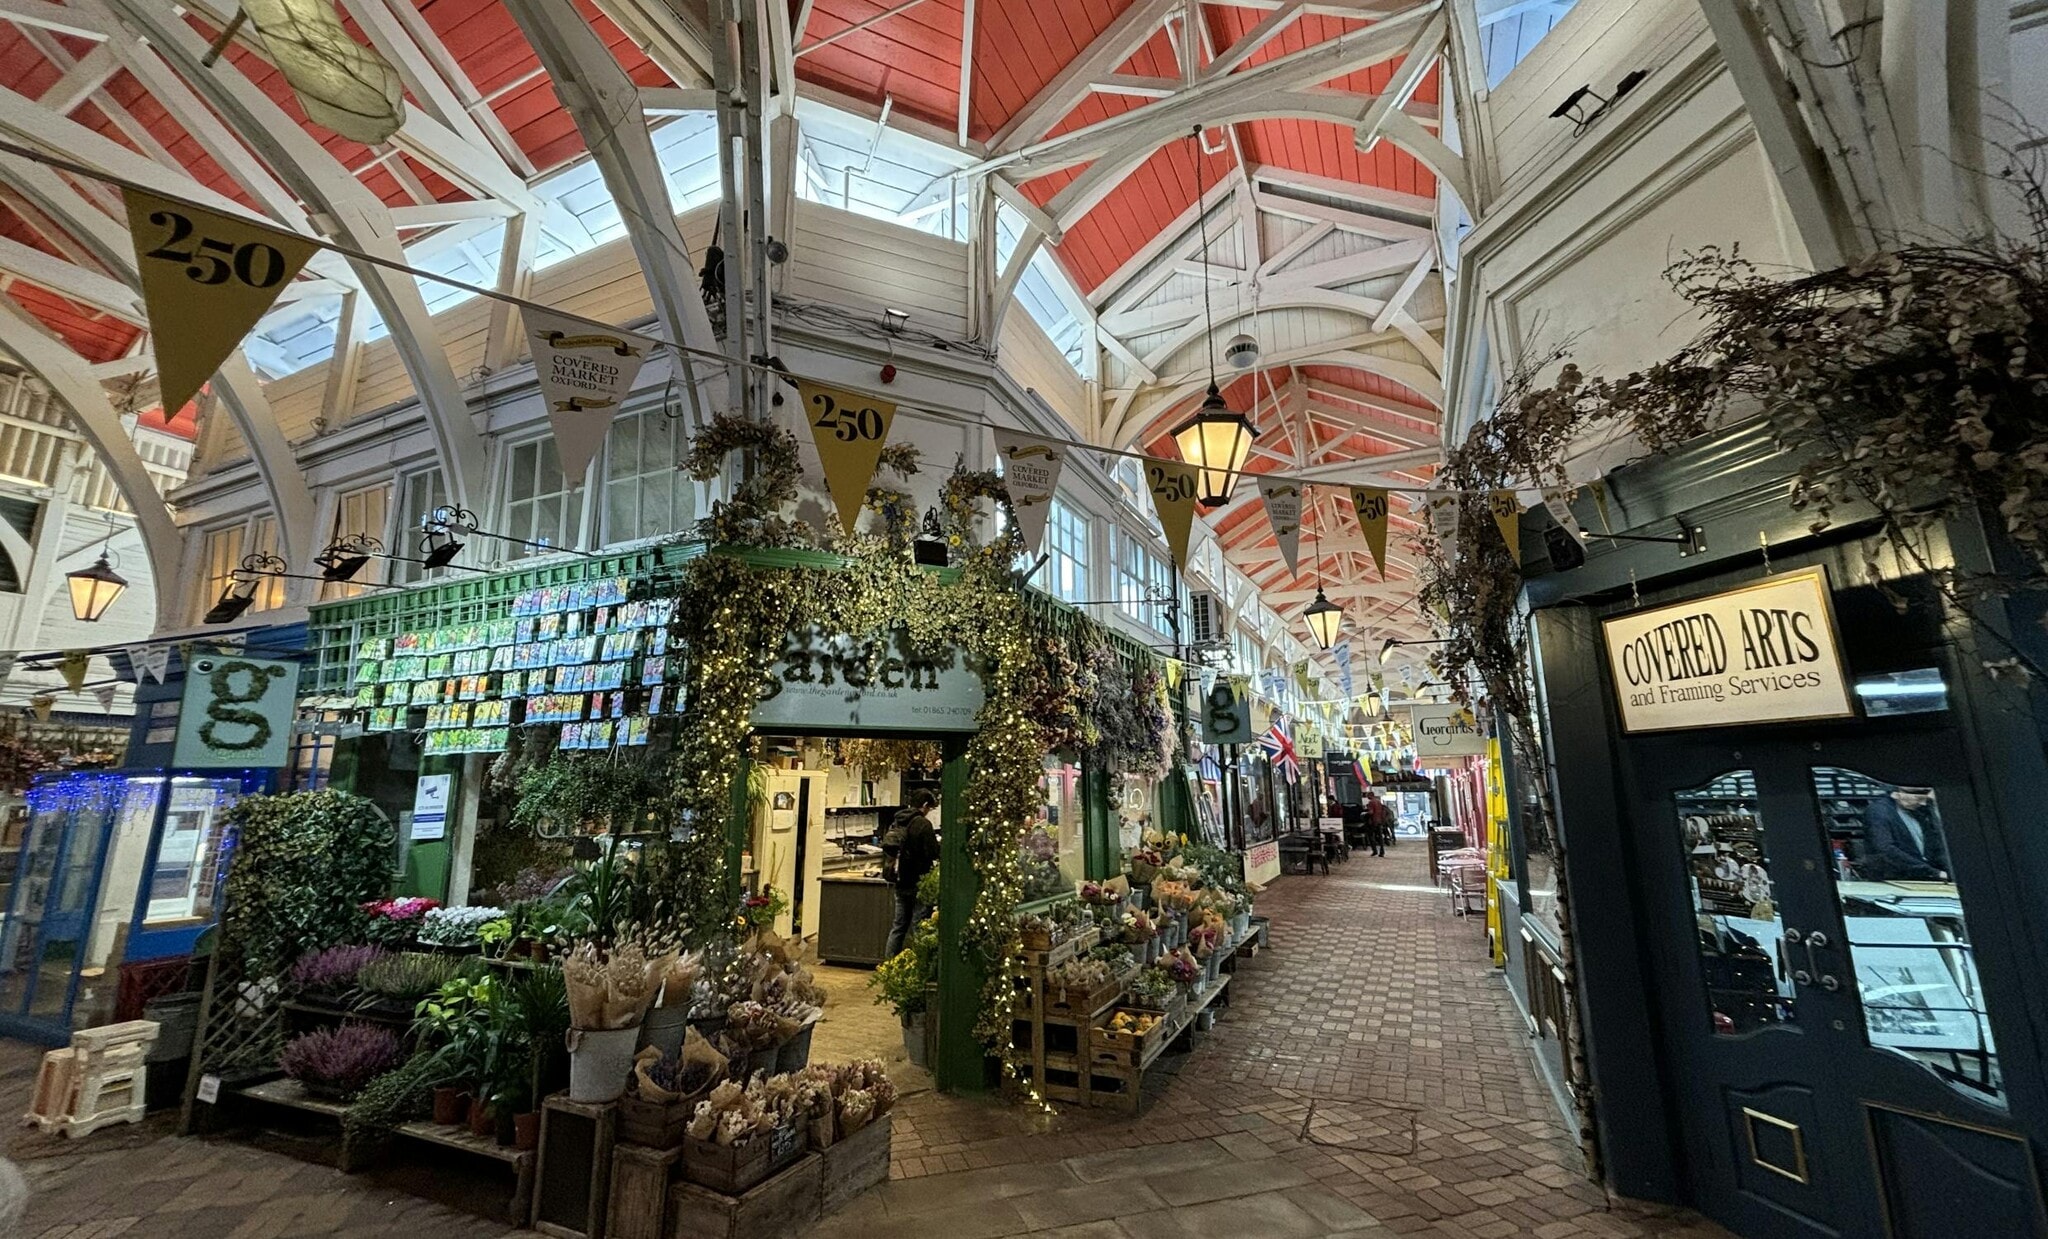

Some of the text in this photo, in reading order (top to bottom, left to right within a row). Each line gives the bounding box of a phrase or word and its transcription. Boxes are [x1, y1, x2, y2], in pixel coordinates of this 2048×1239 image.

[146, 211, 285, 288] 250
[552, 364, 618, 385] MARKET
[553, 354, 619, 376] COVERED
[551, 375, 597, 390] OXFORD
[812, 393, 884, 442] 250
[1012, 464, 1050, 476] COVERED
[1012, 472, 1050, 485] MARKET
[1150, 467, 1195, 502] 250
[1356, 492, 1387, 520] 250
[1492, 495, 1516, 518] 250
[1623, 608, 1820, 686] COVERED ARTS
[1631, 671, 1821, 707] and Framing Services
[197, 660, 286, 751] g
